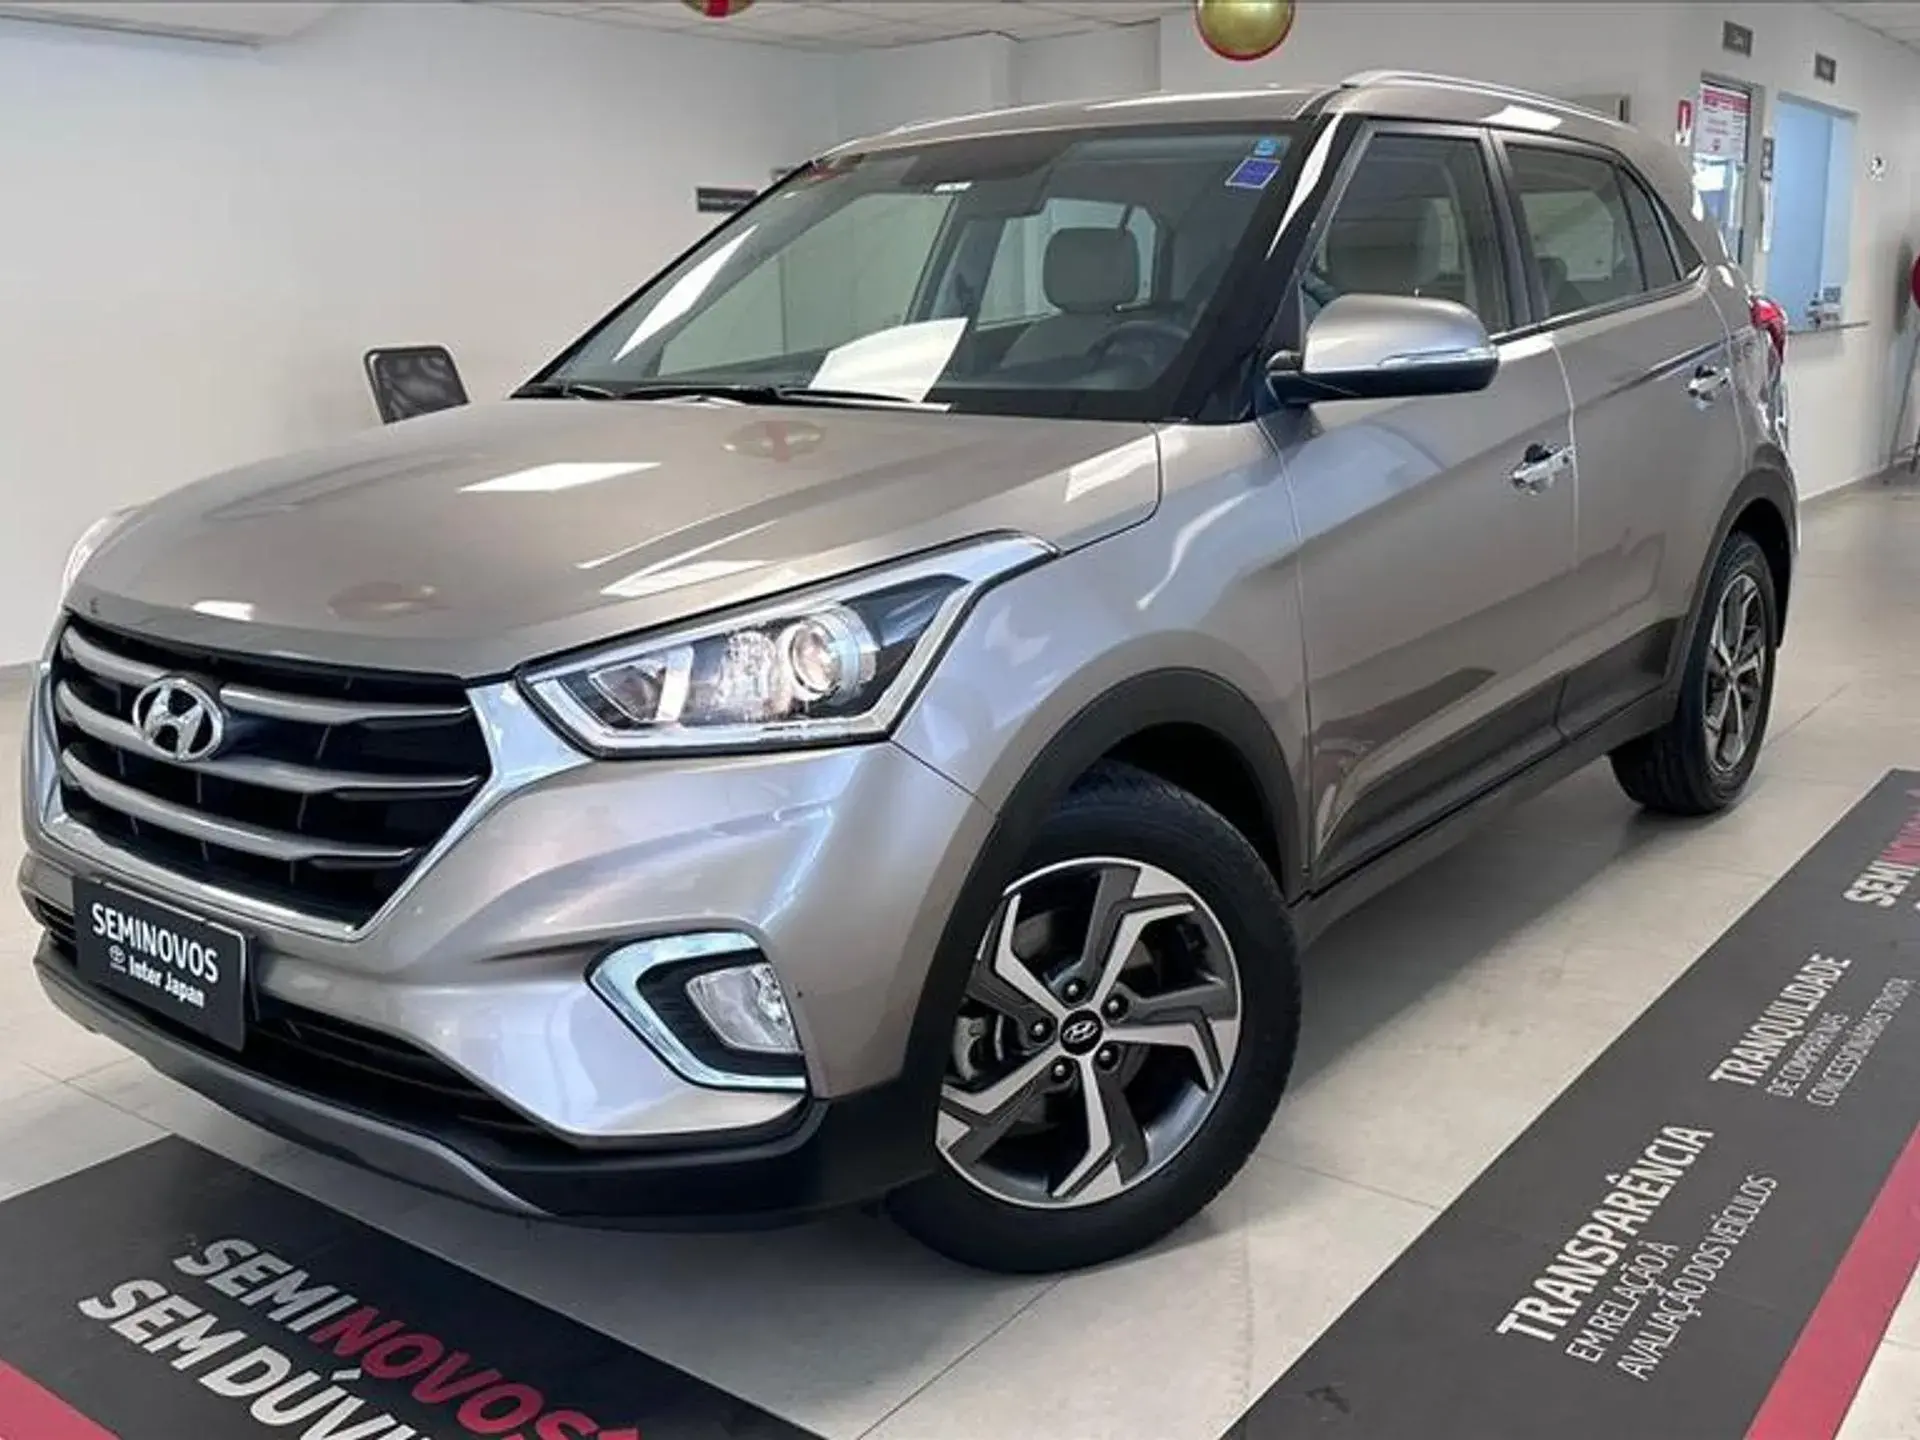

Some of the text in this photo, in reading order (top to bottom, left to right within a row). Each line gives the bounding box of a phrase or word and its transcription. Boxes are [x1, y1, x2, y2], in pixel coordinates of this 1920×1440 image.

[92, 903, 218, 983] SEMINOVOS
[165, 972, 205, 1008] Japan
[1708, 953, 1852, 1085] TRANQUILIDADE
[1496, 1126, 1714, 1341] TRANSPARÊNCIA
[1616, 1173, 1778, 1381] AVALIAÇÃO DOS VEÍCULOS
[77, 1279, 247, 1371] SEM
[1588, 1252, 1670, 1334] RELAÇÃO
[1565, 1329, 1615, 1363] EM
